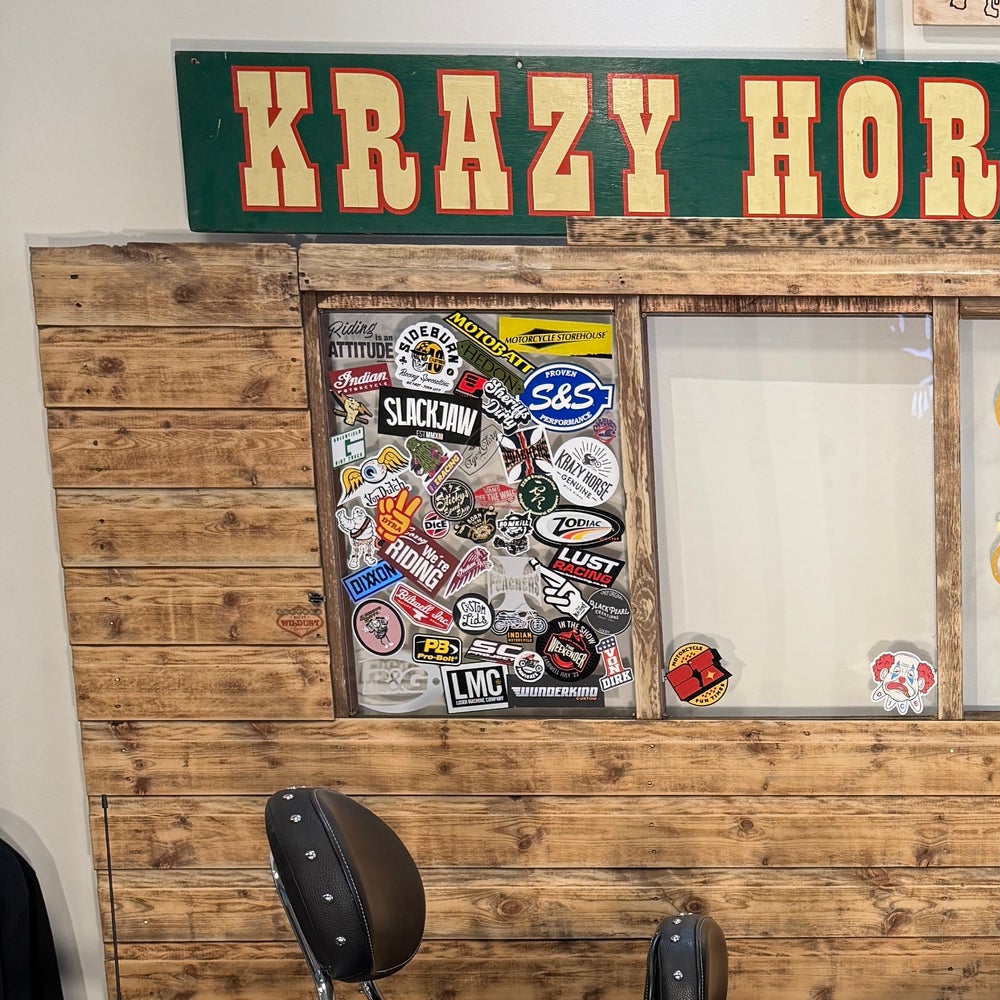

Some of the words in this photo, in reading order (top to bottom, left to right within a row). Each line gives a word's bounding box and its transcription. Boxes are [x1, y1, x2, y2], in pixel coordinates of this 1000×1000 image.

[231, 65, 680, 217] KRAZY
[328, 320, 377, 339] Riding
[449, 312, 535, 373] MOTOBATT
[505, 333, 556, 344] MOTORCYCLE
[557, 331, 607, 342] STOREHOUSE
[328, 341, 394, 359] ATTITUDE
[399, 325, 459, 364] SIDEBURN
[333, 370, 389, 390] Indian
[464, 344, 517, 391] HEDON
[544, 370, 577, 379] PROVEN
[485, 379, 531, 420] Sheriffs
[529, 383, 597, 411] S&S
[384, 397, 478, 437] SLACKJAW
[482, 400, 518, 431] Dirty
[540, 411, 593, 426] PERFORMANCE
[555, 450, 583, 478] KRAZY
[364, 488, 379, 505] Von
[378, 477, 406, 498] Dutch
[561, 474, 592, 498] GENUINE
[583, 469, 613, 501] HORSE
[553, 516, 602, 537] ZODIAC
[385, 538, 444, 590] RIDING
[421, 544, 450, 573] We're
[557, 547, 620, 574] LUST
[350, 564, 398, 596] DIXXON
[552, 560, 613, 585] RACING
[396, 588, 434, 614] Biltwell
[462, 612, 488, 627] Lids
[558, 620, 567, 630] IN
[567, 620, 579, 631] THE
[579, 624, 597, 645] SHOW
[424, 638, 450, 654] PB
[470, 639, 524, 657] SC
[507, 631, 532, 639] INDIAN
[547, 637, 588, 669] WEEKENDER
[606, 647, 621, 675] VON
[671, 645, 704, 667] MOTORCYCLE
[451, 669, 503, 700] LMC
[511, 686, 599, 698] WUNDERKIND
[602, 670, 632, 690] DIRK
[710, 682, 726, 702] TIMES
